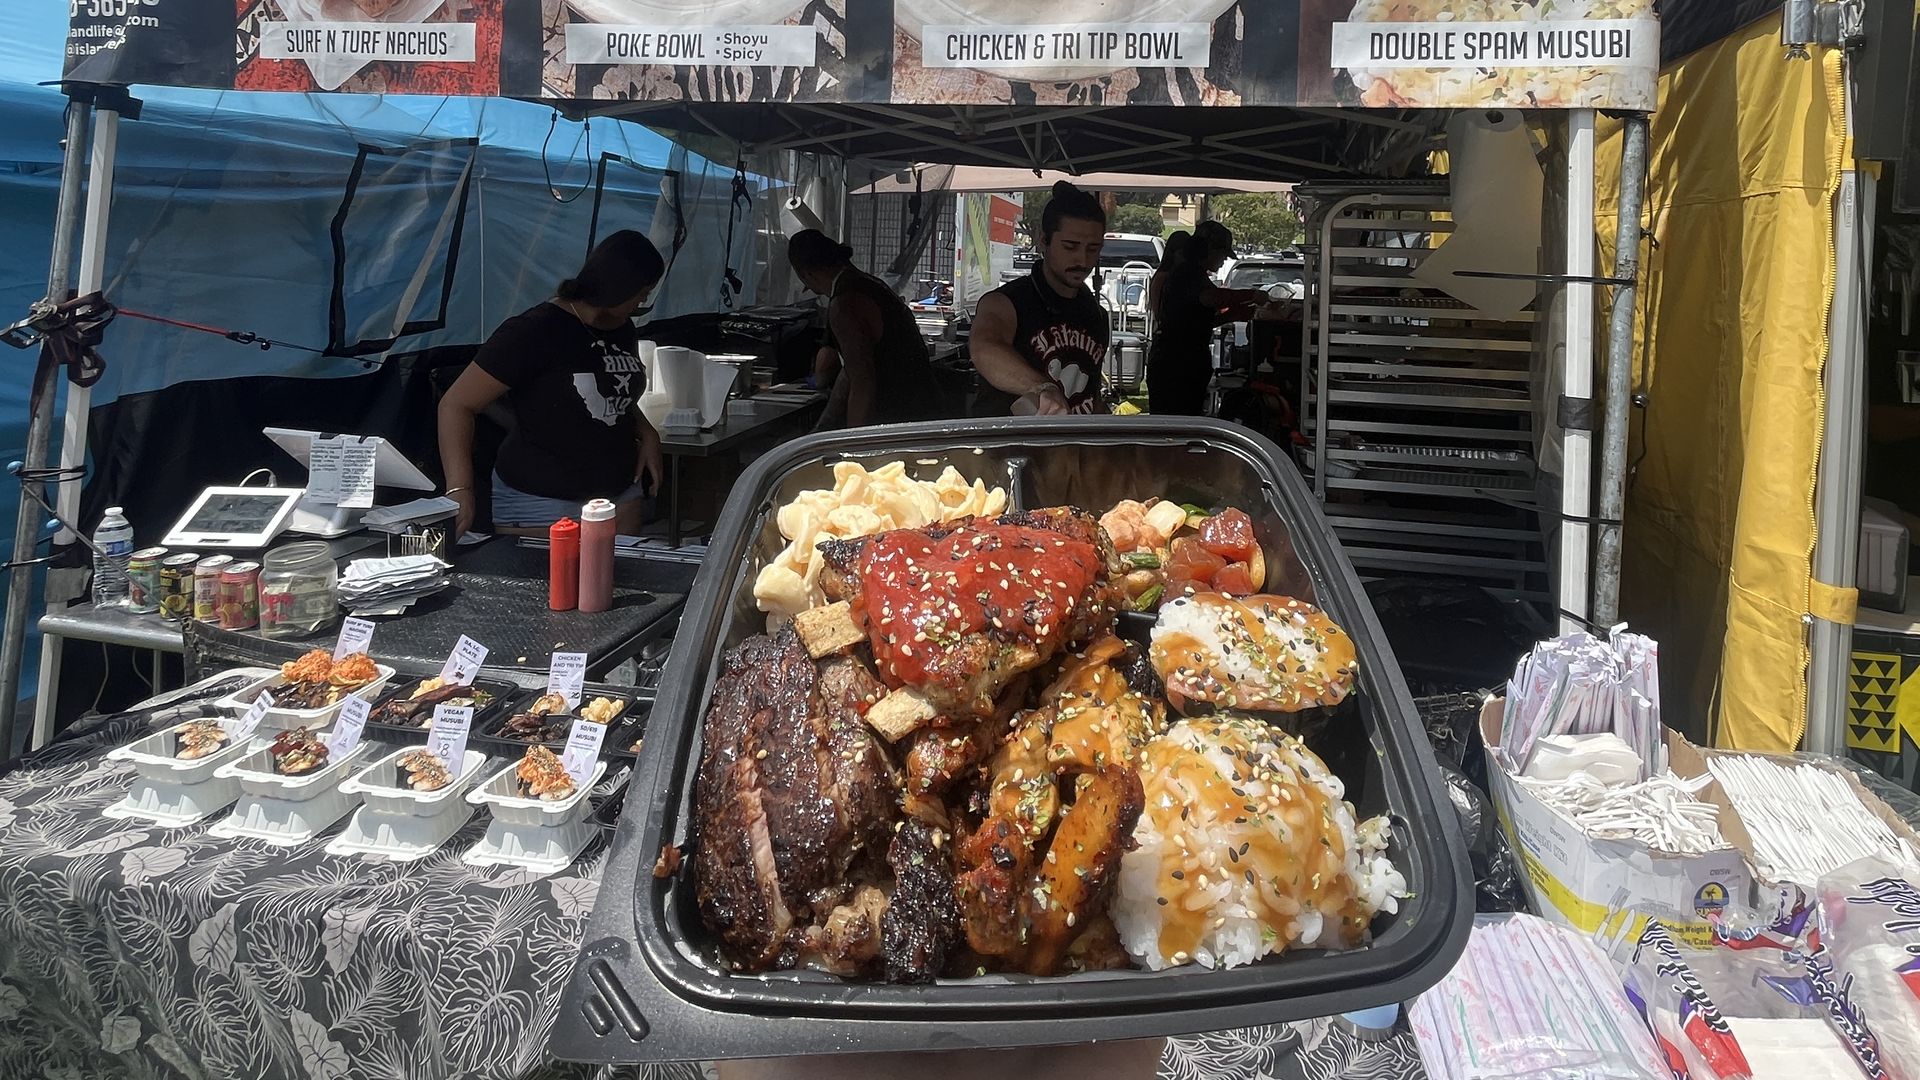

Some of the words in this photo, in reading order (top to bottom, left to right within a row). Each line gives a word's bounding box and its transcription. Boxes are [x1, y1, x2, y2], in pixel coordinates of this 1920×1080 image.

[286, 29, 321, 53] SURF
[326, 30, 337, 53] N
[342, 30, 381, 54] TURF
[385, 31, 447, 55] NACHOS
[606, 32, 650, 58] POKE
[656, 33, 705, 59] BOWL
[723, 32, 768, 46] Shoyu
[946, 34, 1027, 60] CHICKEN
[1033, 34, 1046, 59] &
[1052, 33, 1081, 59] TRI
[1088, 32, 1118, 59] TIP
[1125, 32, 1183, 59] BOWL
[1370, 32, 1456, 60] DOUBLE
[1463, 31, 1528, 60] SPAM
[1537, 29, 1631, 59] MUSUBI
[723, 47, 763, 62] Spicy
